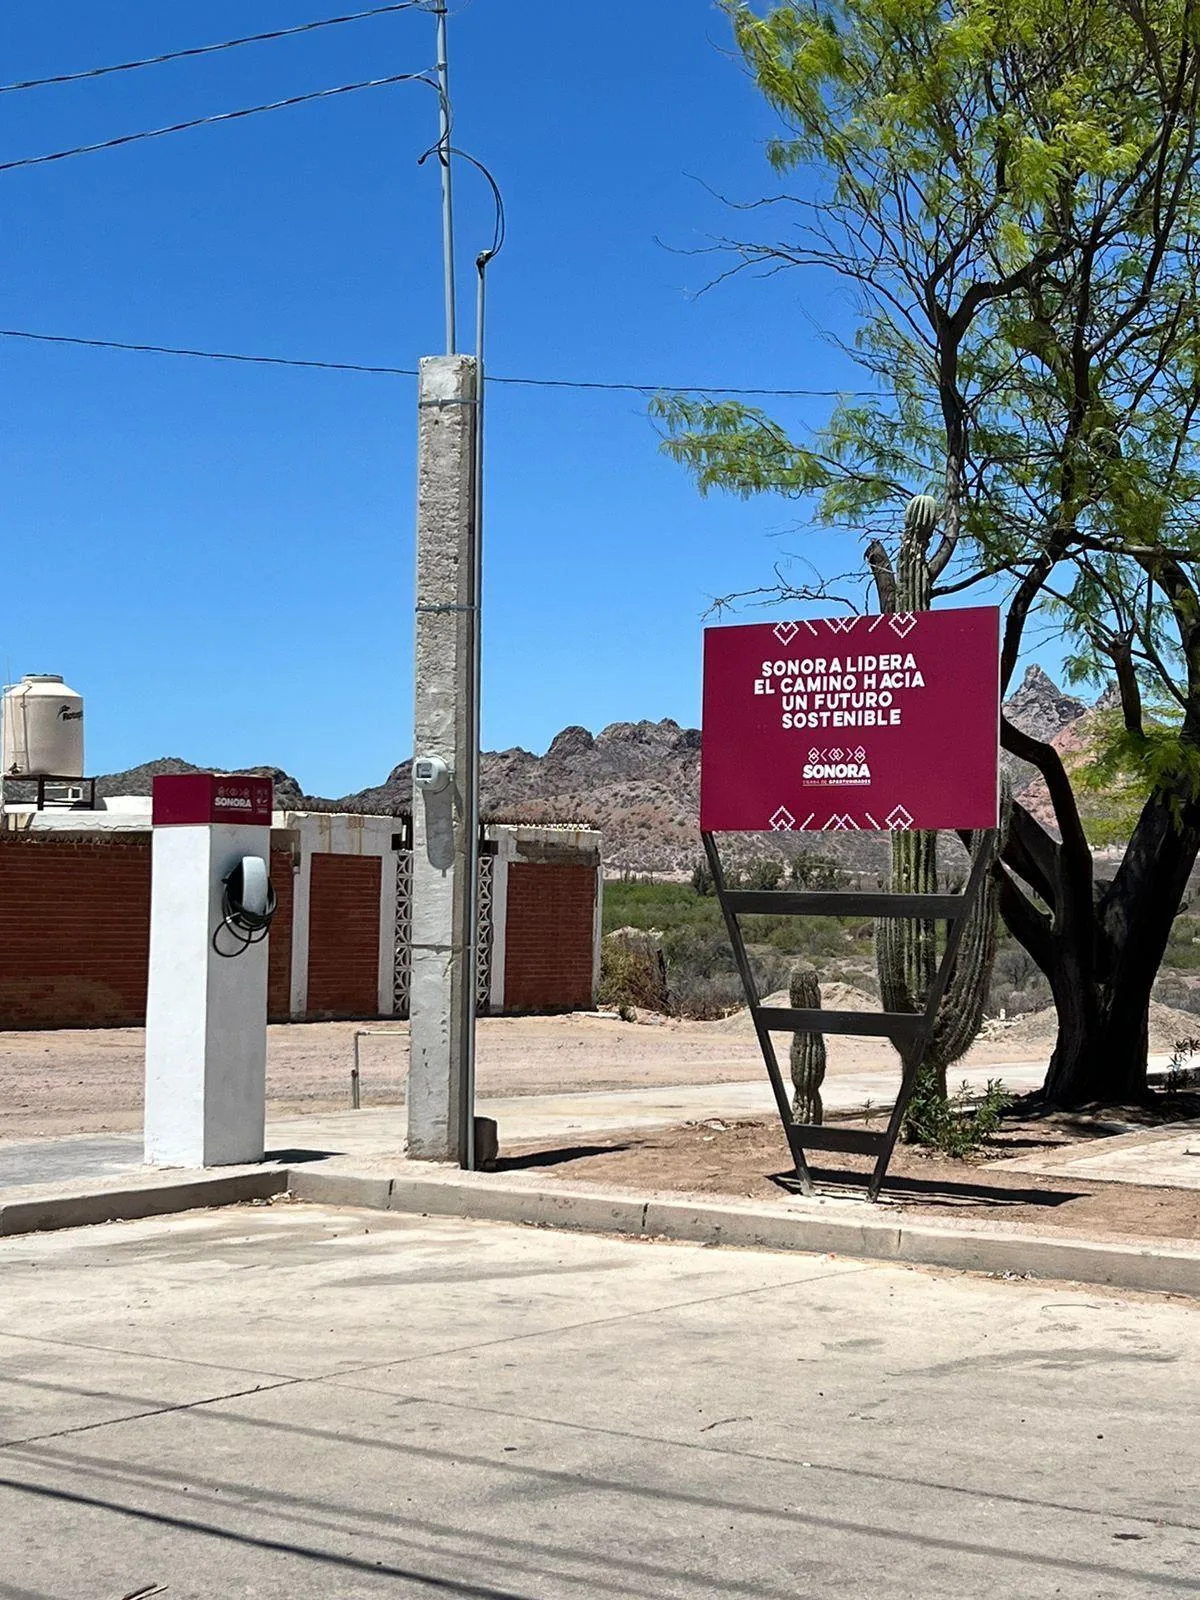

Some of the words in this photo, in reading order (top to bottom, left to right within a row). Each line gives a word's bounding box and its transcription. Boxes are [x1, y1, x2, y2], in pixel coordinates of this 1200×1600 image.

[761, 657, 843, 677] SONORA
[846, 653, 917, 672] LIDERA
[754, 678, 775, 695] EL
[780, 674, 857, 694] CAMINO
[863, 671, 926, 690] HACIA
[781, 694, 808, 711] UN
[814, 691, 893, 710] FUTURO
[781, 708, 902, 729] SOSTENIBLE
[802, 763, 871, 779] SONORA
[214, 797, 252, 808] SONORA
